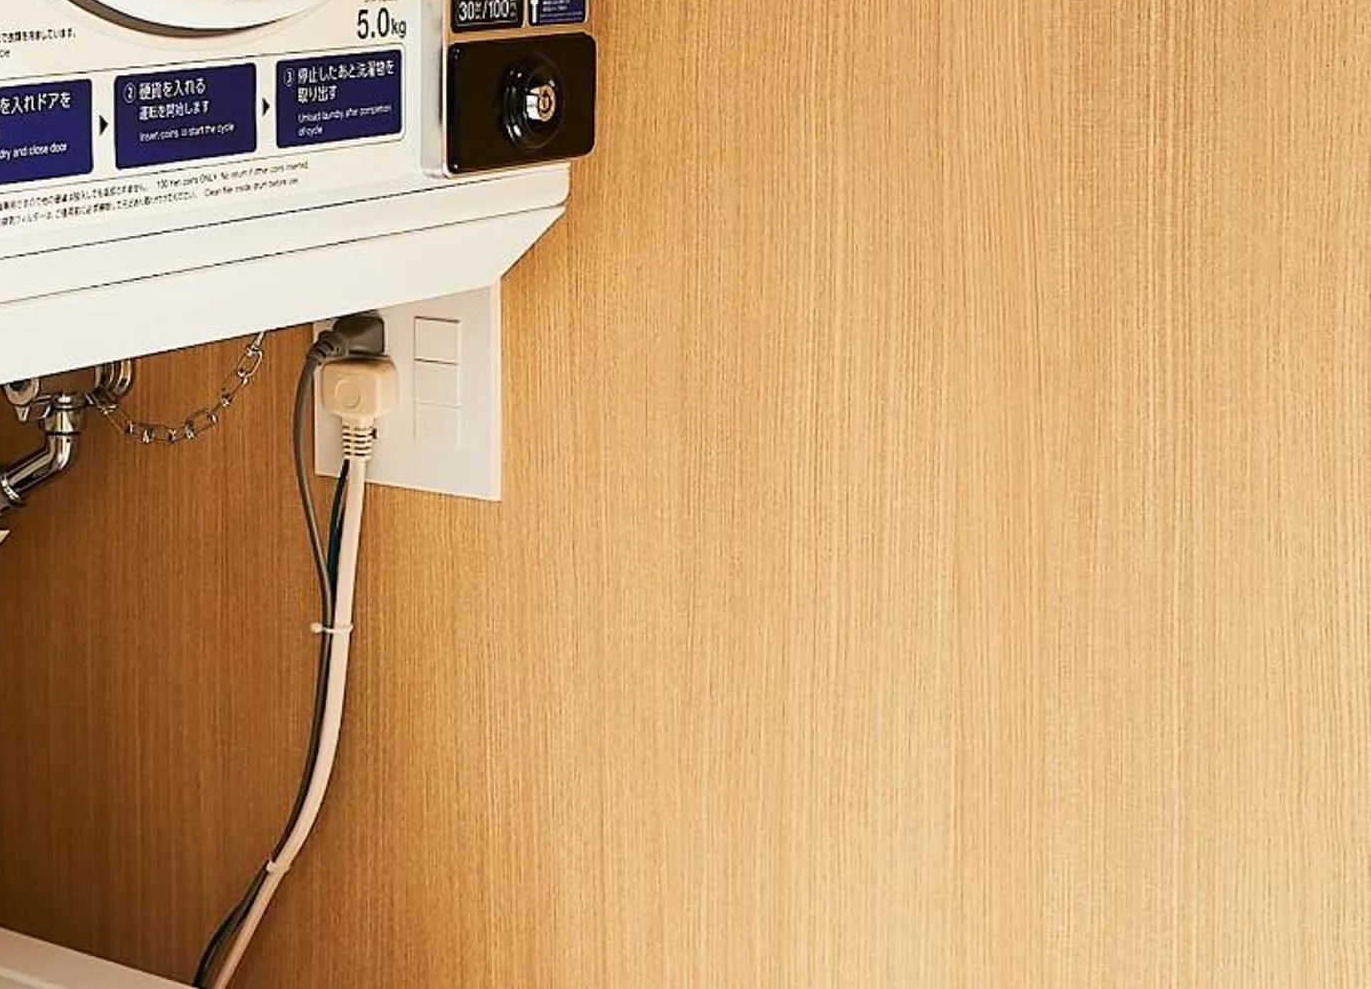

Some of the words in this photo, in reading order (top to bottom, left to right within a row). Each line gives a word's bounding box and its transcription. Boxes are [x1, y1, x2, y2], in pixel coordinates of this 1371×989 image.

[357, 7, 407, 39] 5.0kg
[139, 78, 206, 100] 硬貨を入れる
[298, 85, 338, 103] 取り出す
[13, 147, 28, 158] and
[29, 144, 49, 156] close
[50, 142, 67, 153] door
